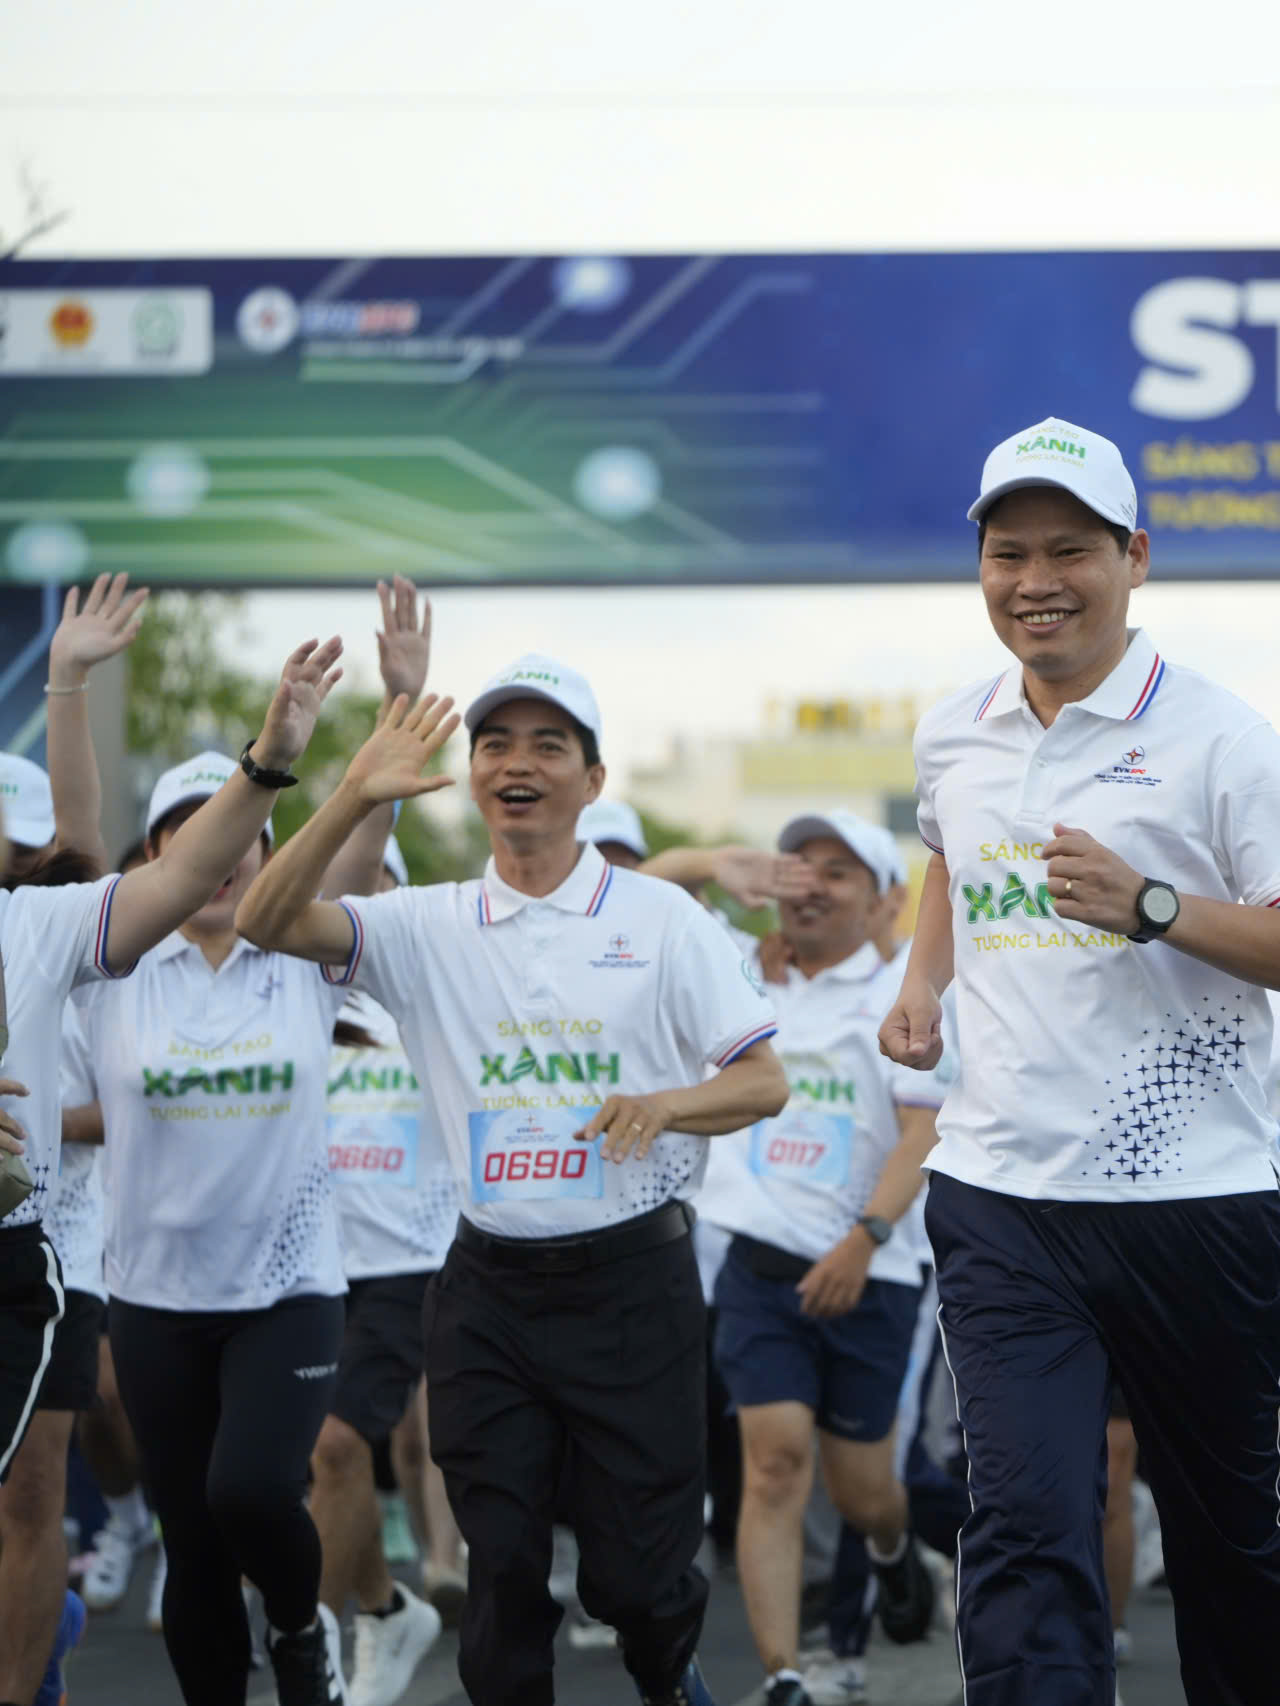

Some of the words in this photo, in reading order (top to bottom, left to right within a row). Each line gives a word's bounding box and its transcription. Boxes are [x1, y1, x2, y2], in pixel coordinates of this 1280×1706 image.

[1016, 436, 1086, 459] XANH
[962, 872, 1056, 924] XA
[1036, 931, 1066, 948] LAI
[142, 1060, 295, 1098] XANH
[327, 1066, 420, 1095] ANH
[480, 1046, 621, 1087] XANH
[789, 1077, 856, 1104] NH
[484, 1148, 589, 1184] 0690
